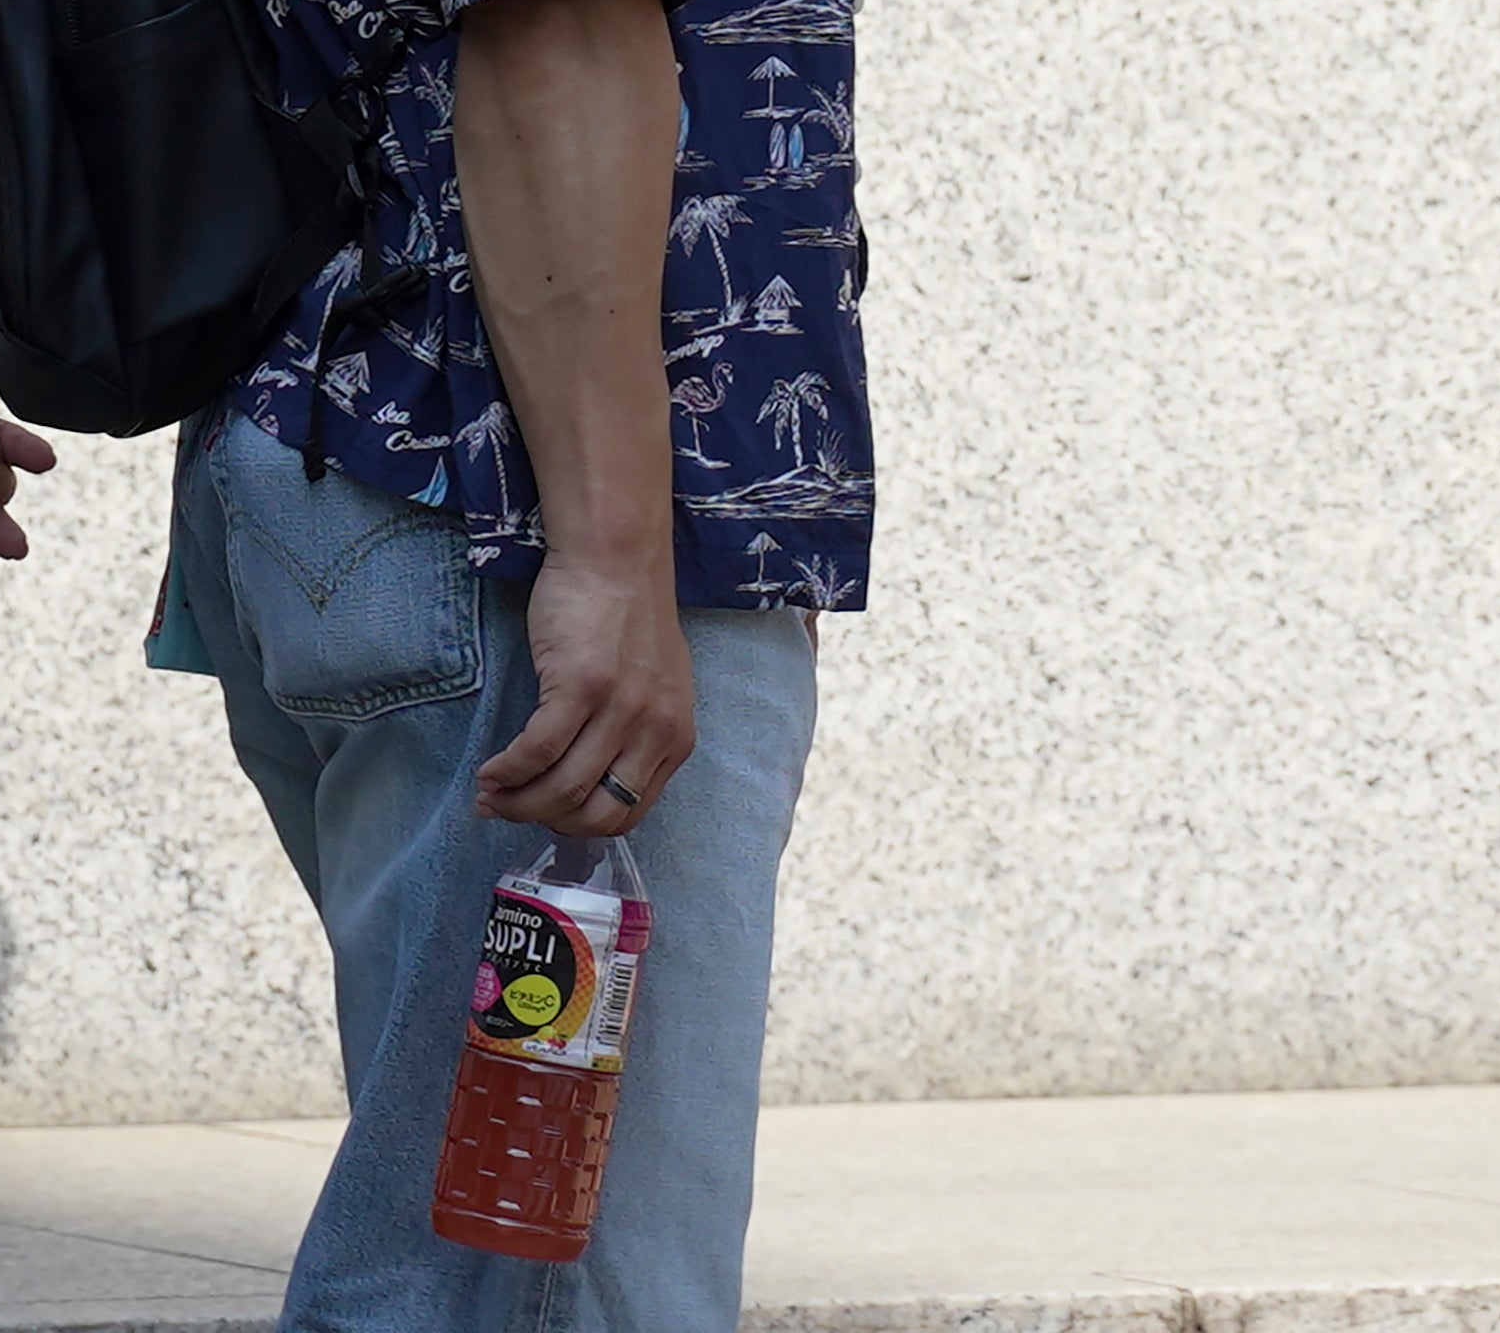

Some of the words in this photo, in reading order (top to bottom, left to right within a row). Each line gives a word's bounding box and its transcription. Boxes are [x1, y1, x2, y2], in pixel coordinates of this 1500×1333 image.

[371, 400, 412, 426] Sea
[385, 429, 451, 452] Cruise
[494, 906, 542, 930] amino
[483, 919, 557, 965] SUPLI
